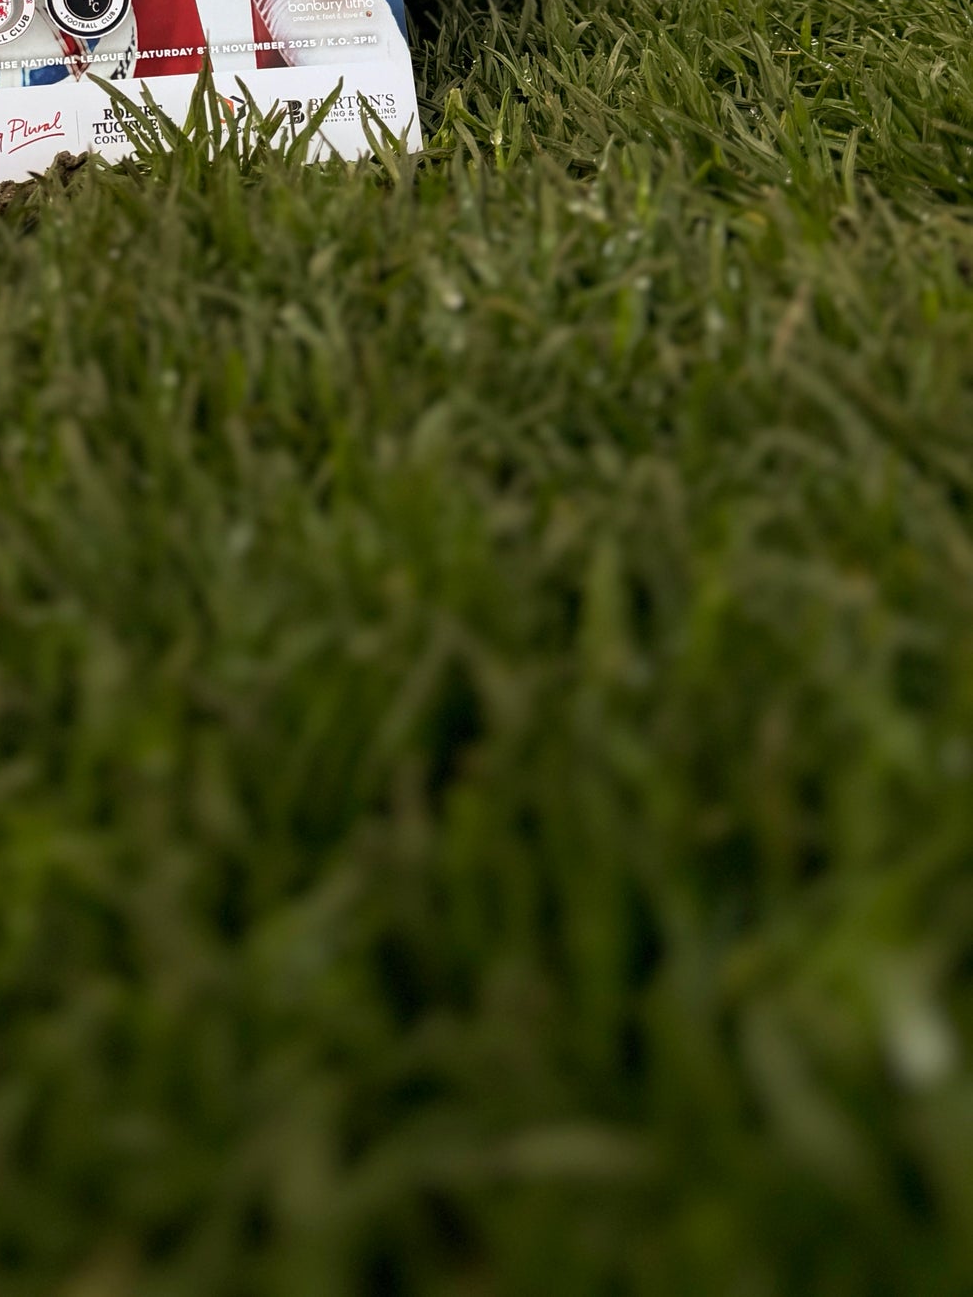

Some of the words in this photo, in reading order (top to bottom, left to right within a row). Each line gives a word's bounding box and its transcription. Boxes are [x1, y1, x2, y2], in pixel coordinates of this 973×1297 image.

[288, 0, 343, 14] banbury
[9, 14, 30, 37] CLUB
[64, 14, 98, 29] FOOTBALL
[101, 11, 117, 25] CLUB
[20, 56, 78, 69] NATIONAL
[81, 52, 125, 64] LEAGUE
[135, 47, 194, 60] SATURDAY
[197, 45, 219, 56] 8H
[222, 41, 286, 54] NOVEMBER
[288, 38, 317, 49] 2025
[326, 36, 351, 47] K.O.
[353, 35, 378, 46] 3PM
[309, 93, 396, 112] BRTON'S
[7, 111, 62, 142] Plural
